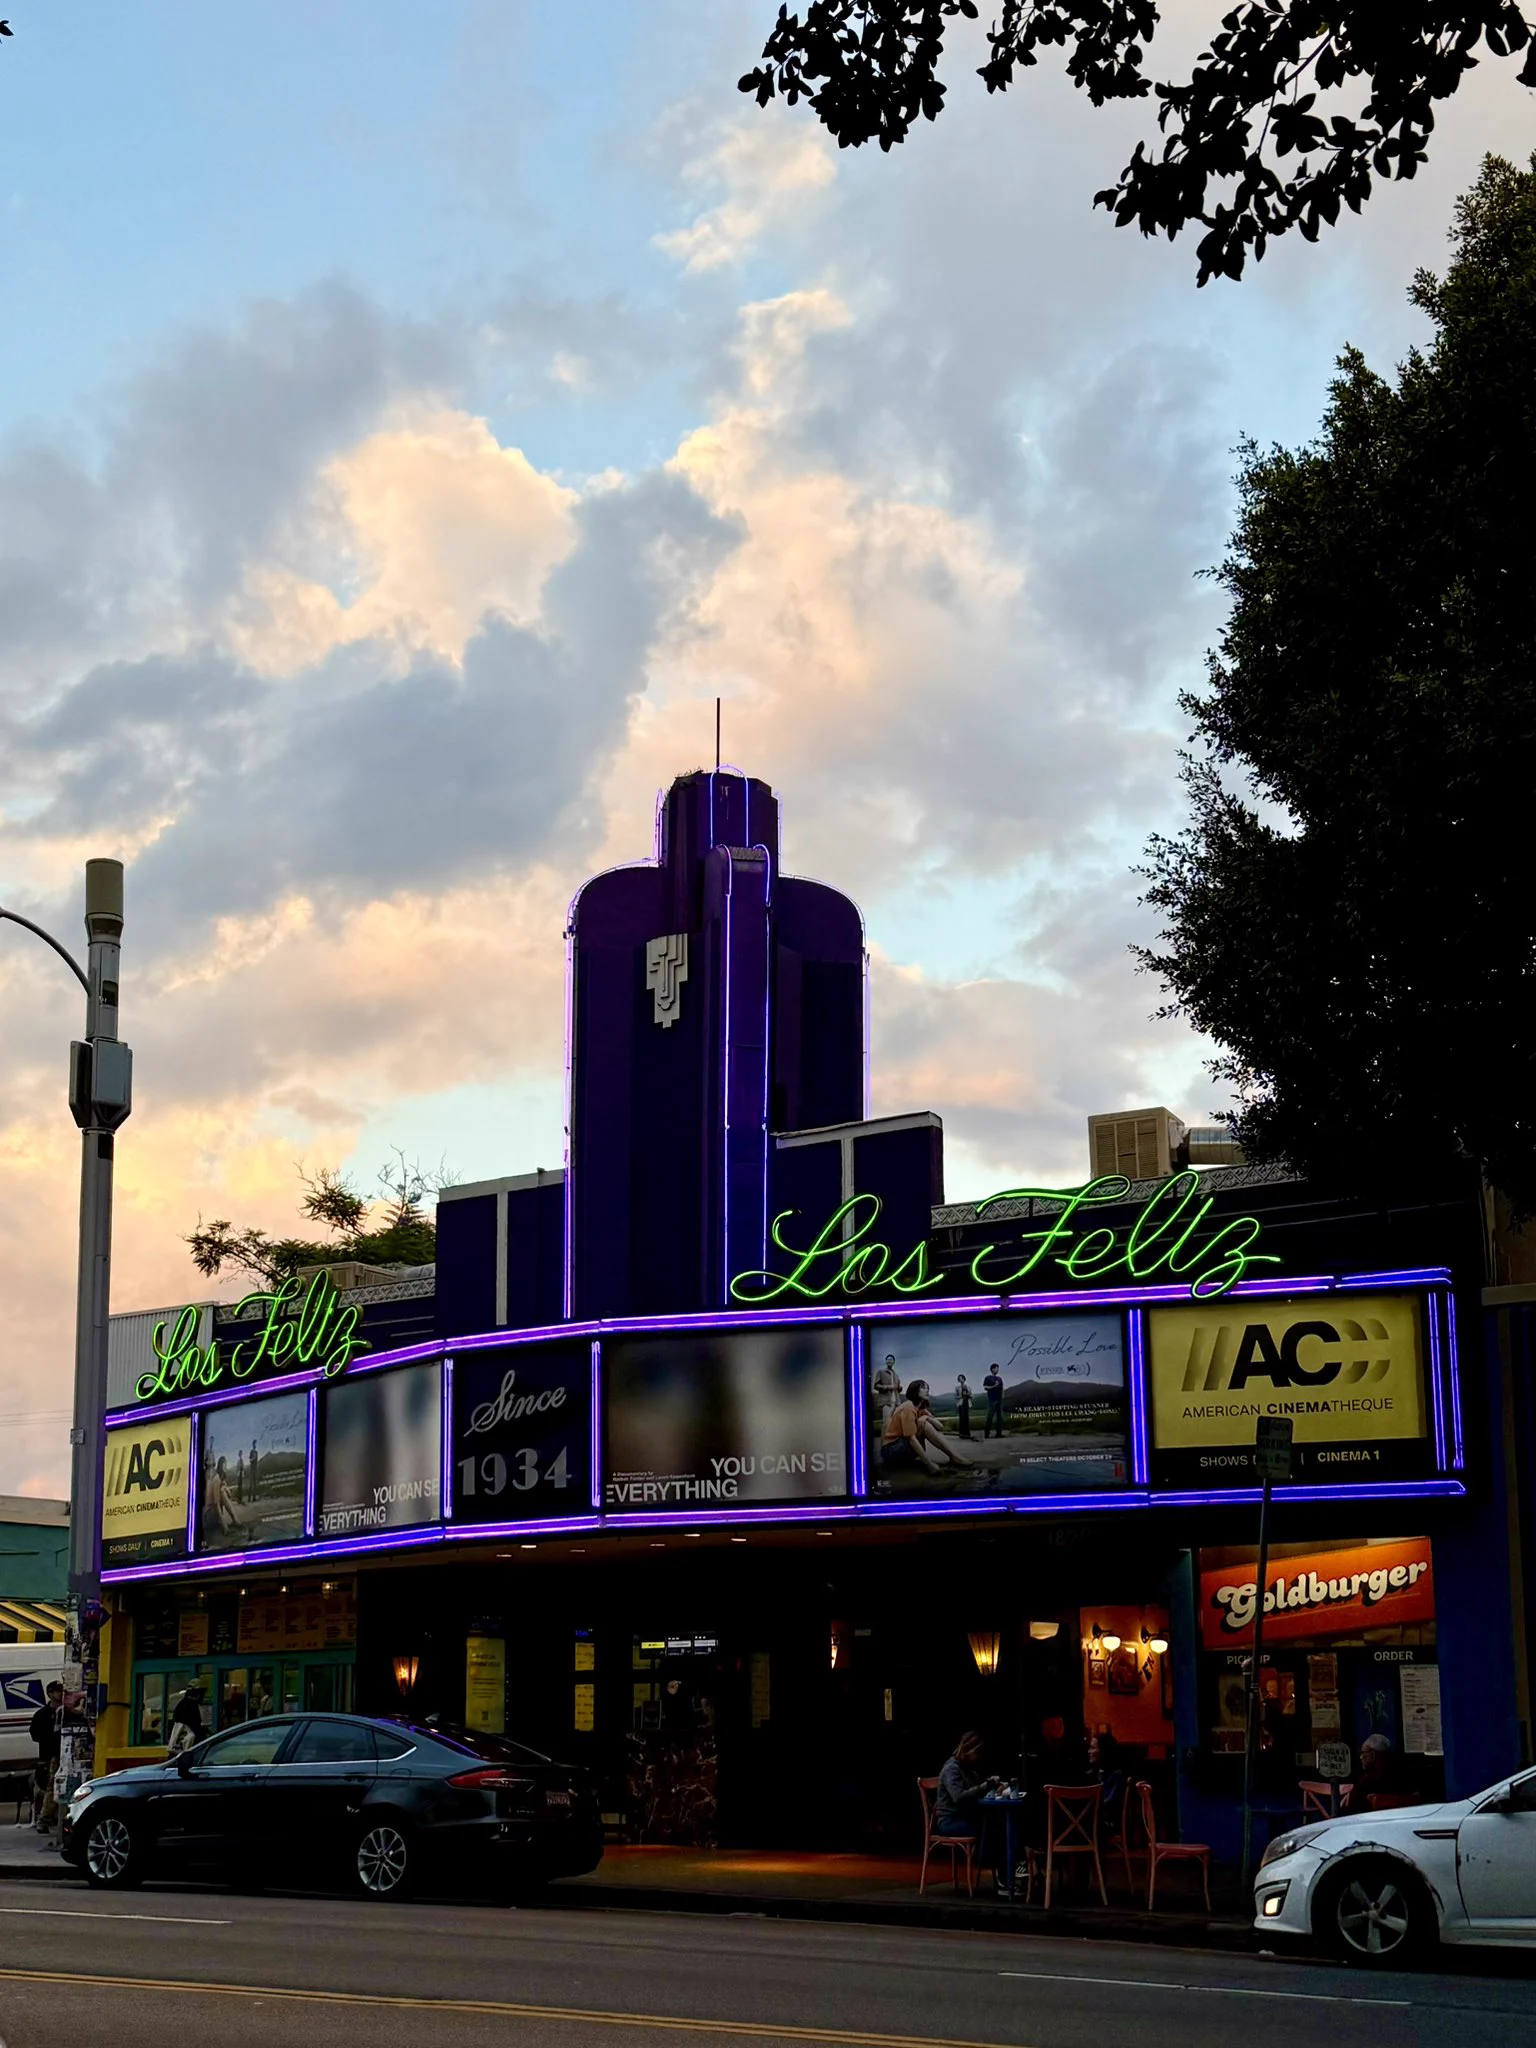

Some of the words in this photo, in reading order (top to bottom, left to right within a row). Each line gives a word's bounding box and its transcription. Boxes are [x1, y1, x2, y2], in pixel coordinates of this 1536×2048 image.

[730, 1193, 945, 1301] Los
[972, 1170, 1281, 1299] Feliz
[135, 1306, 223, 1400] Los
[231, 1268, 367, 1377] Feliz
[1007, 1333, 1074, 1366] Possible
[1228, 1320, 1342, 1390] AC
[463, 1369, 568, 1437] Since
[1182, 1403, 1262, 1419] AMERICAN
[1266, 1398, 1394, 1415] CINEMATHEQUE
[123, 1439, 166, 1495] AC
[710, 1456, 756, 1477] YOU
[760, 1453, 806, 1475] CAN
[811, 1452, 841, 1472] SE
[1199, 1455, 1249, 1468] SHOWS
[1317, 1450, 1371, 1463] CINEMA
[1373, 1450, 1380, 1461] 1
[457, 1445, 573, 1496] 1934
[373, 1485, 397, 1505] YOU
[397, 1480, 423, 1501] CAN
[606, 1478, 738, 1503] EVERYTHING
[105, 1504, 136, 1517] AMERICAN
[136, 1497, 181, 1513] CINEMATHEQUE
[109, 1544, 128, 1554] SHOWS
[150, 1539, 170, 1548] CINEMA
[1216, 1561, 1428, 1629] Goldburger
[1373, 1650, 1414, 1662] ORDER
